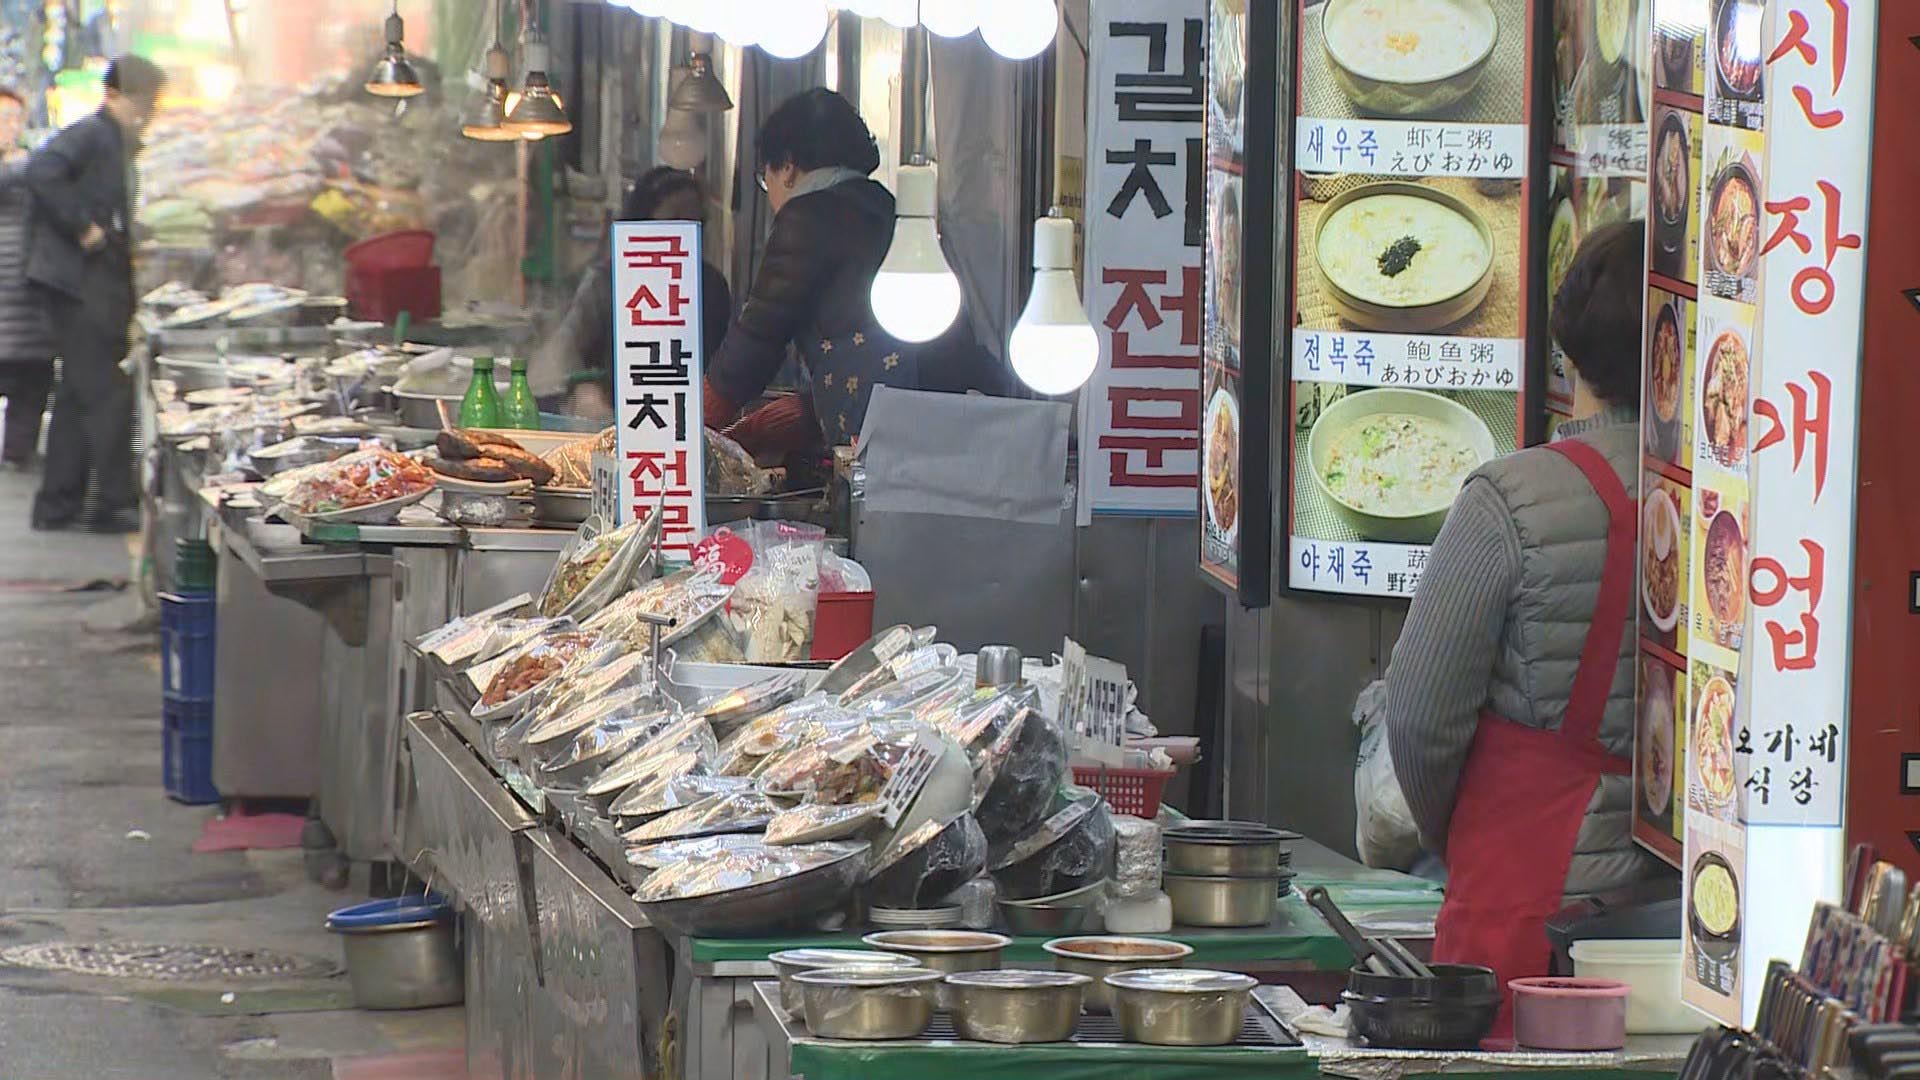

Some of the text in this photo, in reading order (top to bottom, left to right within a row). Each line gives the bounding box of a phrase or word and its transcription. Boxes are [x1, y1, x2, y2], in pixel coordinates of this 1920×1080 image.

[1306, 124, 1379, 168] 새우죽
[1406, 126, 1493, 151] 虾仁粥
[1390, 150, 1514, 174] えびおかゆ
[1303, 333, 1376, 377] 전복죽
[1750, 0, 1862, 672] 신장개업
[1380, 363, 1514, 388] あわびおかゆ
[1300, 543, 1373, 587] 야채죽
[1735, 723, 1839, 763] 오가네
[1743, 766, 1820, 805] 식당
